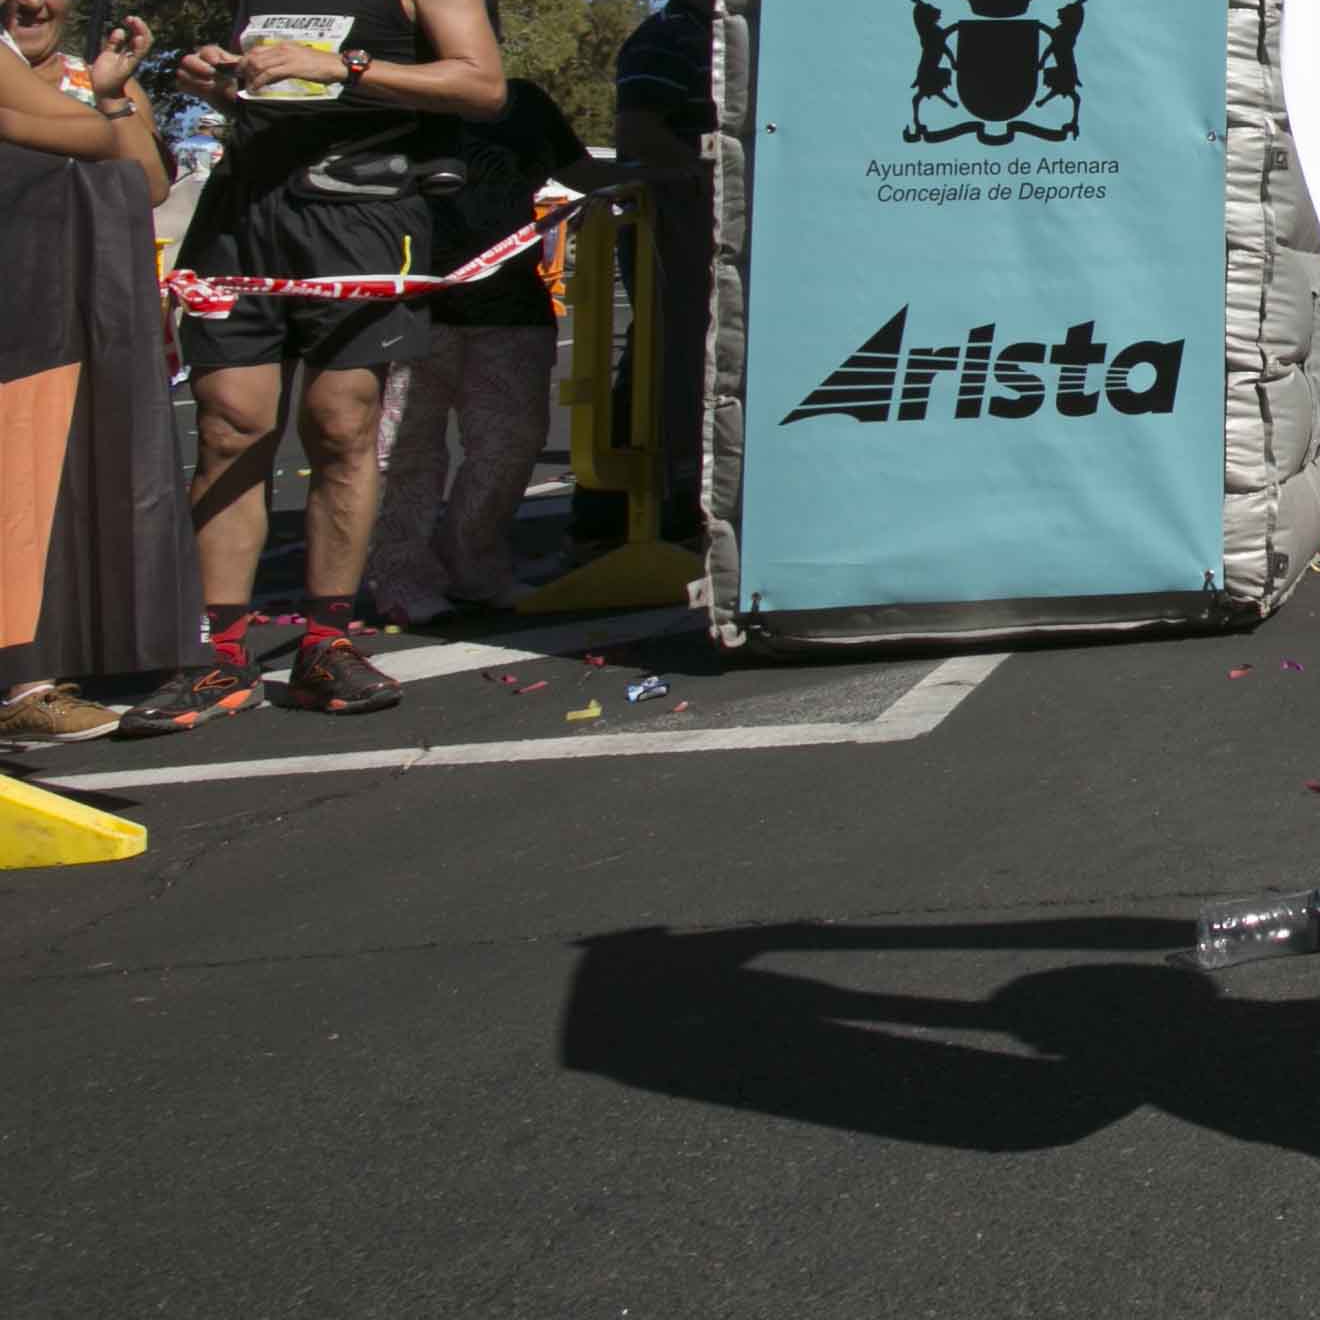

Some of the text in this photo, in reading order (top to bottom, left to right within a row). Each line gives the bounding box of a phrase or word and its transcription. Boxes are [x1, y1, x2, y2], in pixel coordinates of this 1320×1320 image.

[866, 157, 1120, 180] Ayuntamiento de Artenara
[877, 182, 1107, 206] Concejalía de Deportes
[778, 303, 1185, 426] Arista
